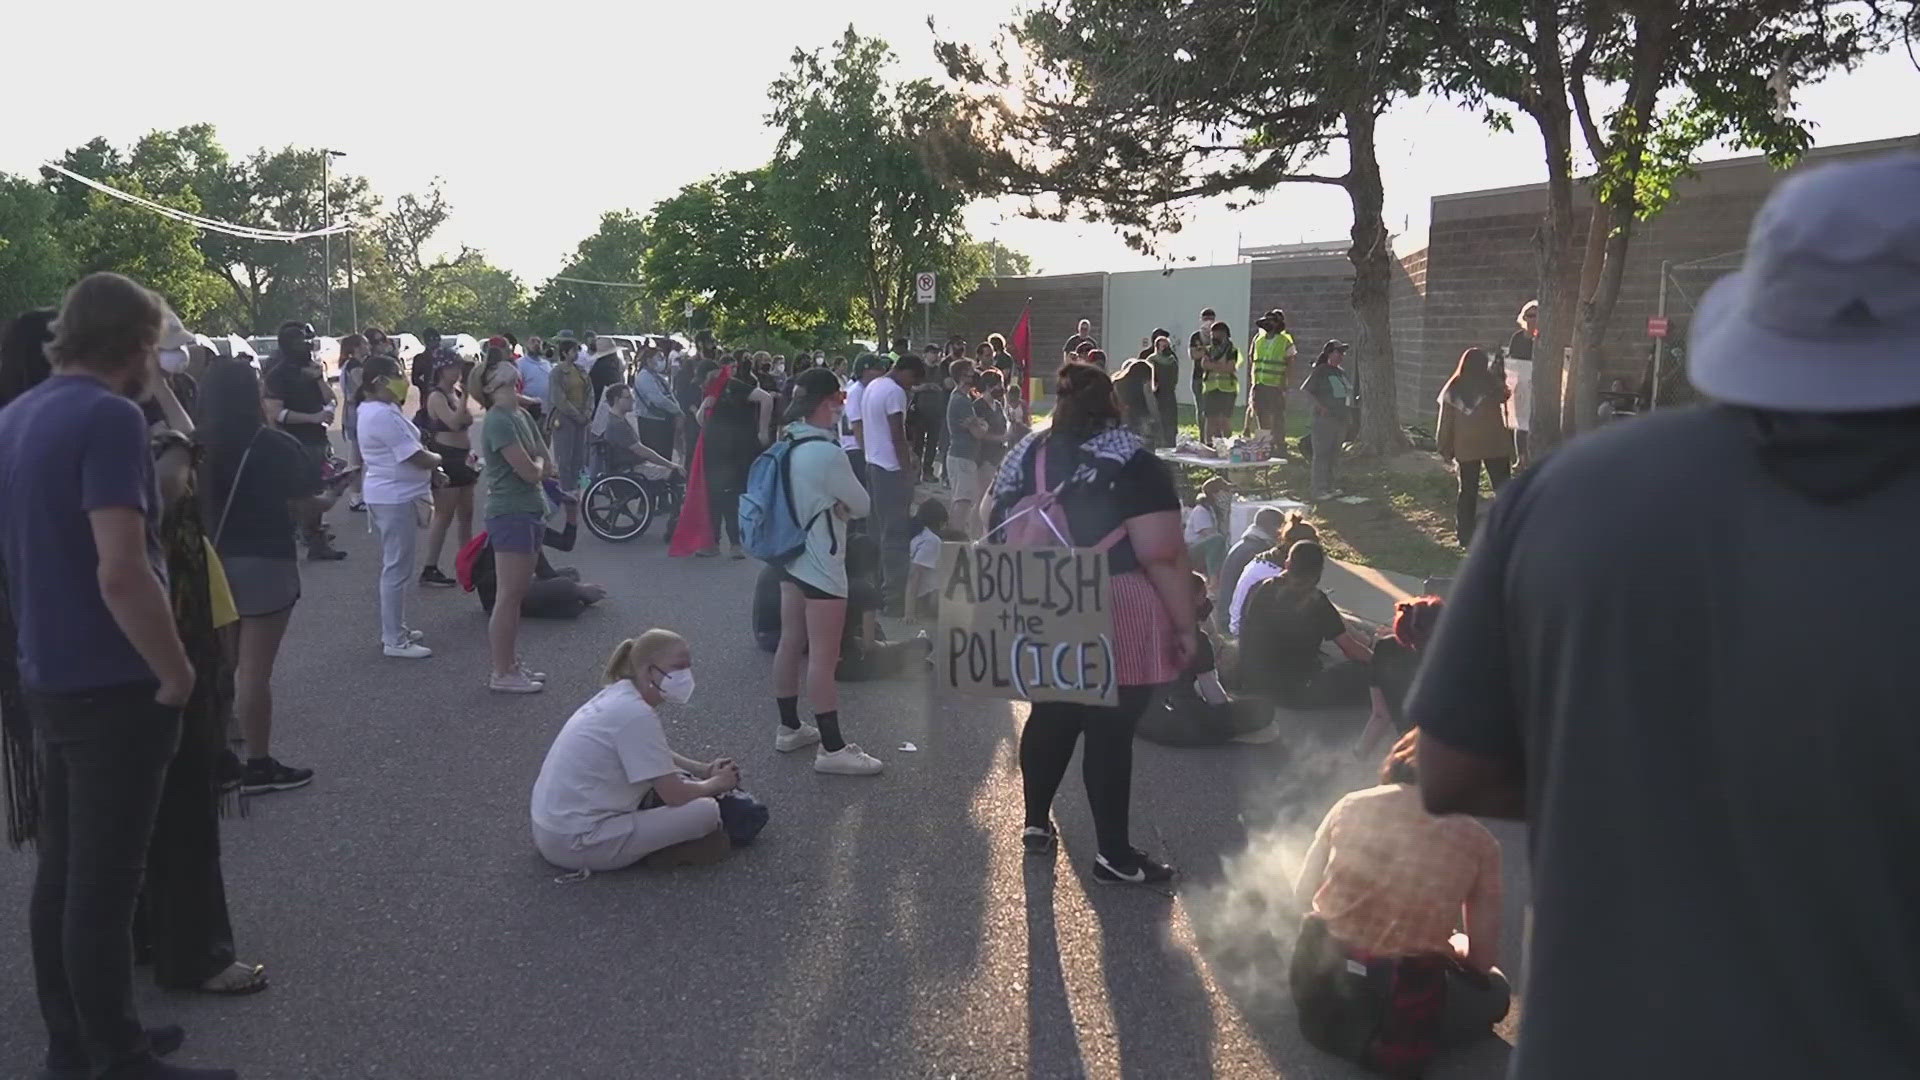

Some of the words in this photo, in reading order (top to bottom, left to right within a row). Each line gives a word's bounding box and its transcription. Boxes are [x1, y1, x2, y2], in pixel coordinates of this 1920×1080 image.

[944, 546, 1102, 616] ABOLISH
[998, 603, 1043, 634] the
[950, 627, 1115, 699] POL(ICE)
